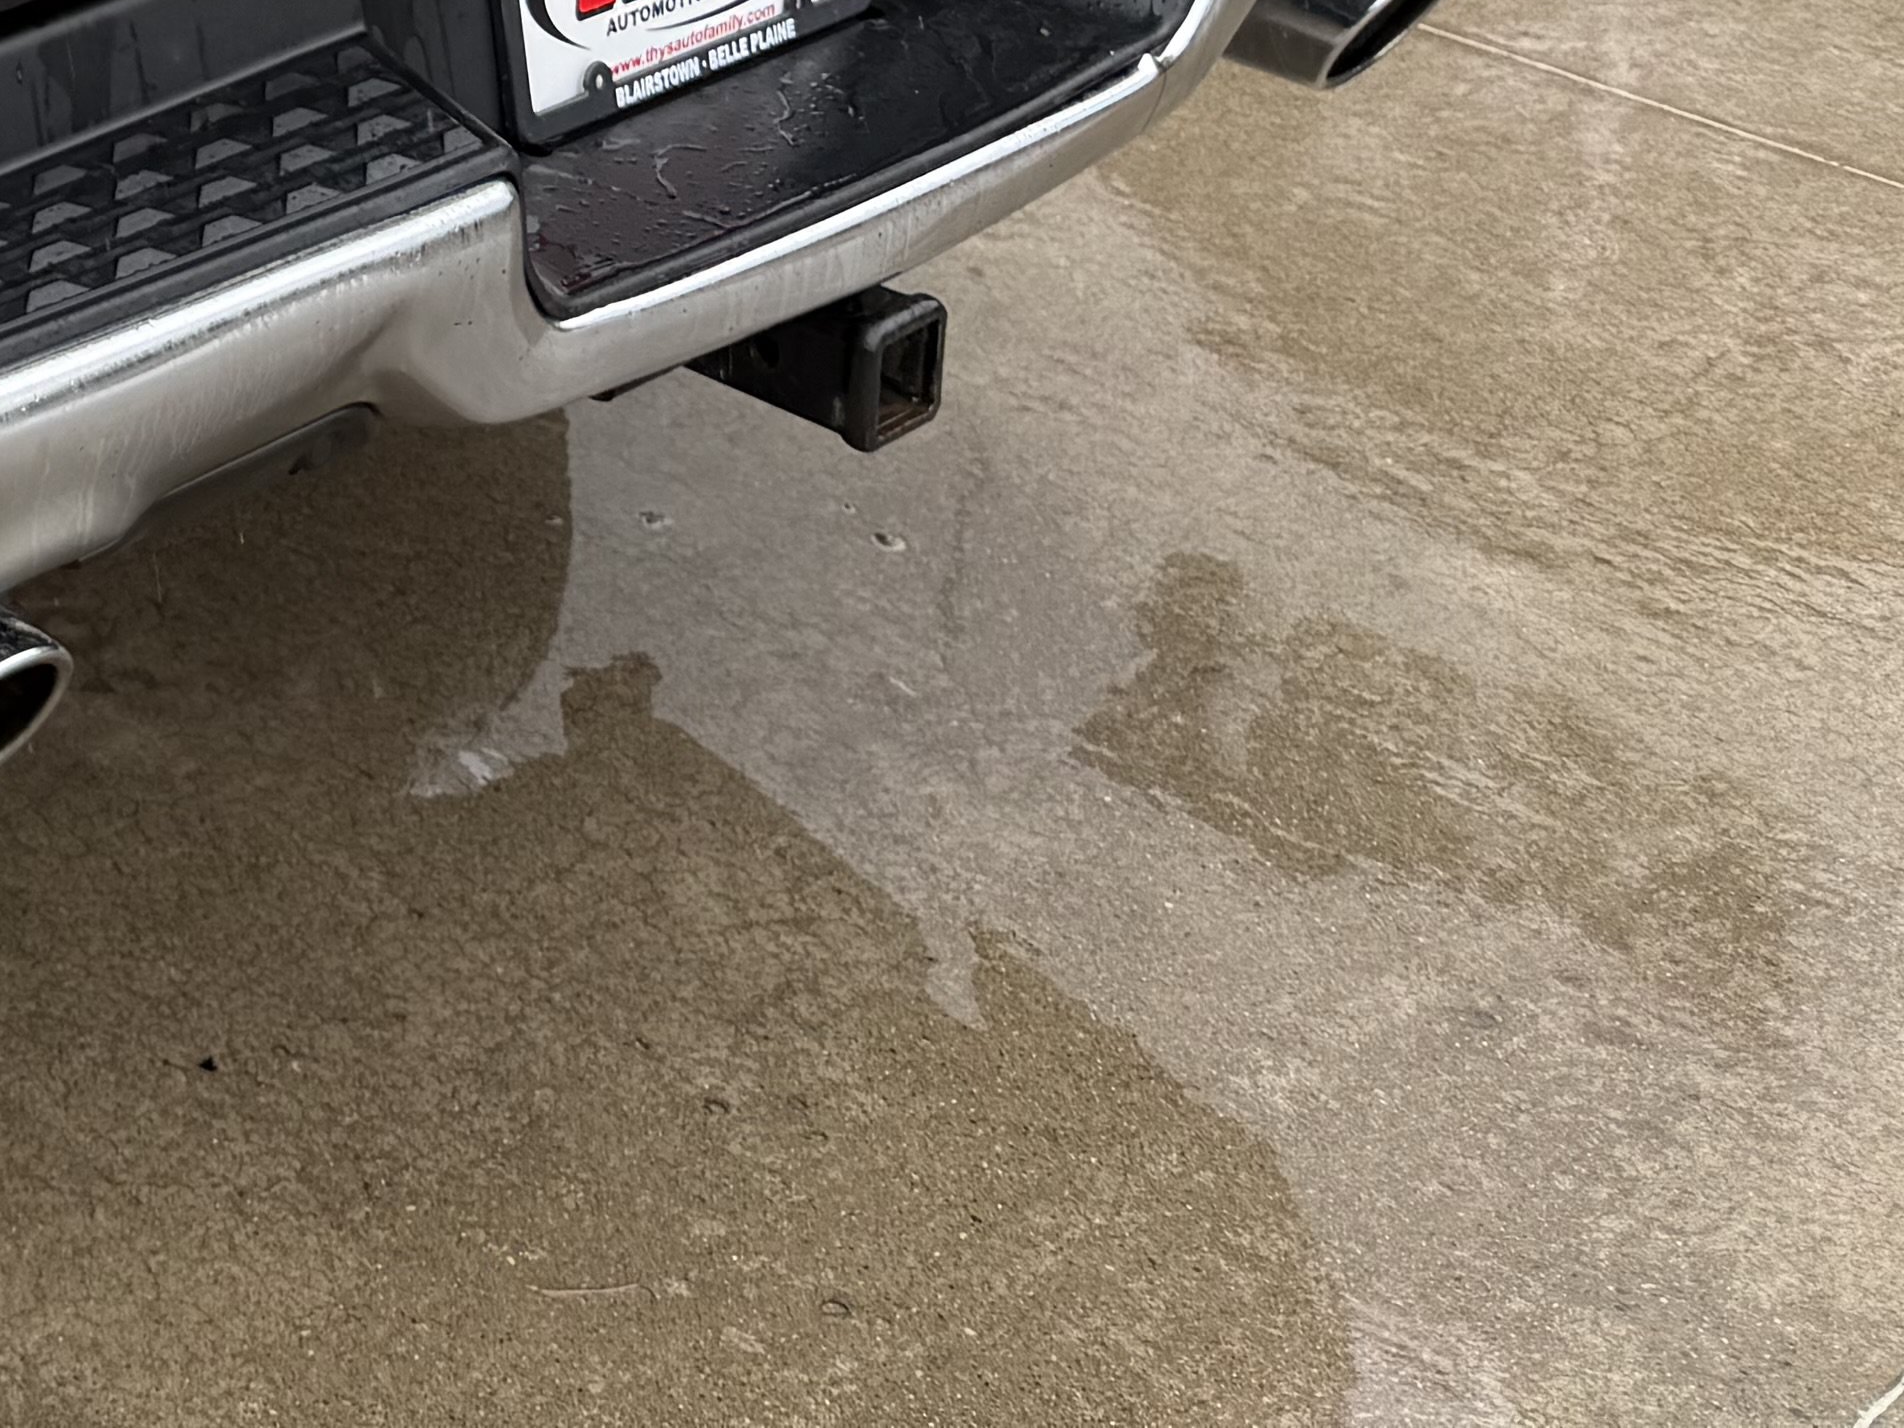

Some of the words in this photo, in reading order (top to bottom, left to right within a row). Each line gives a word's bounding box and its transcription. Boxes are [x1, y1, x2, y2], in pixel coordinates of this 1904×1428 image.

[615, 56, 701, 108] BLAIRSTOWN
[708, 37, 749, 71] BELLE
[750, 18, 797, 54] PLAINE
